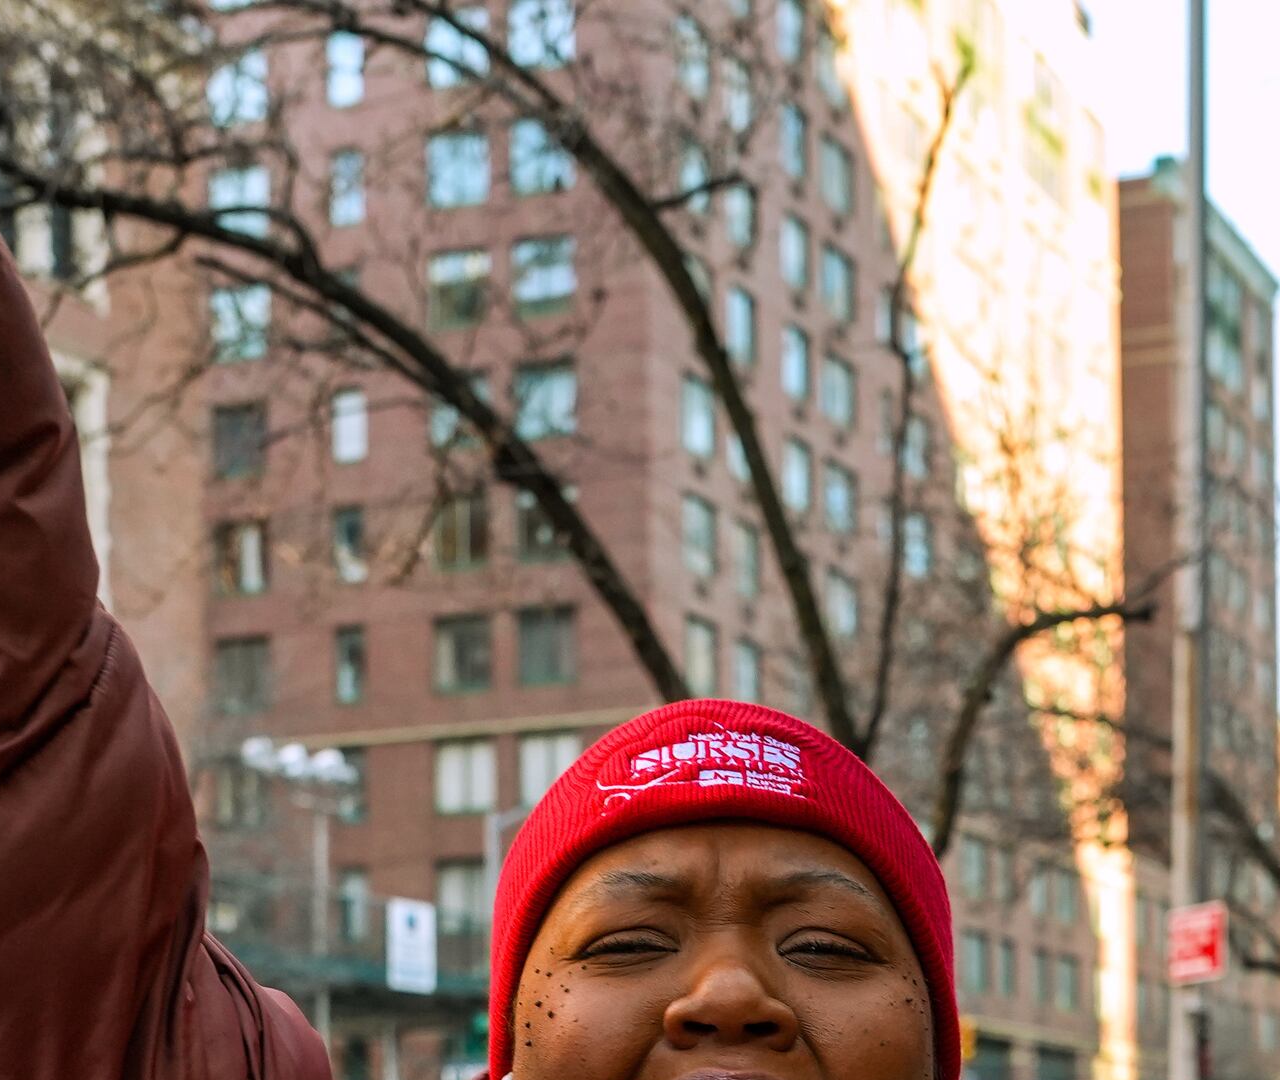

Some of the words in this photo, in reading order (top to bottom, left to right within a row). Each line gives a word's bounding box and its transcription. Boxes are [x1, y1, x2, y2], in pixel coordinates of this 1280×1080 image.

[688, 732, 724, 742] New
[726, 730, 761, 743] York
[630, 741, 801, 771] NURSES
